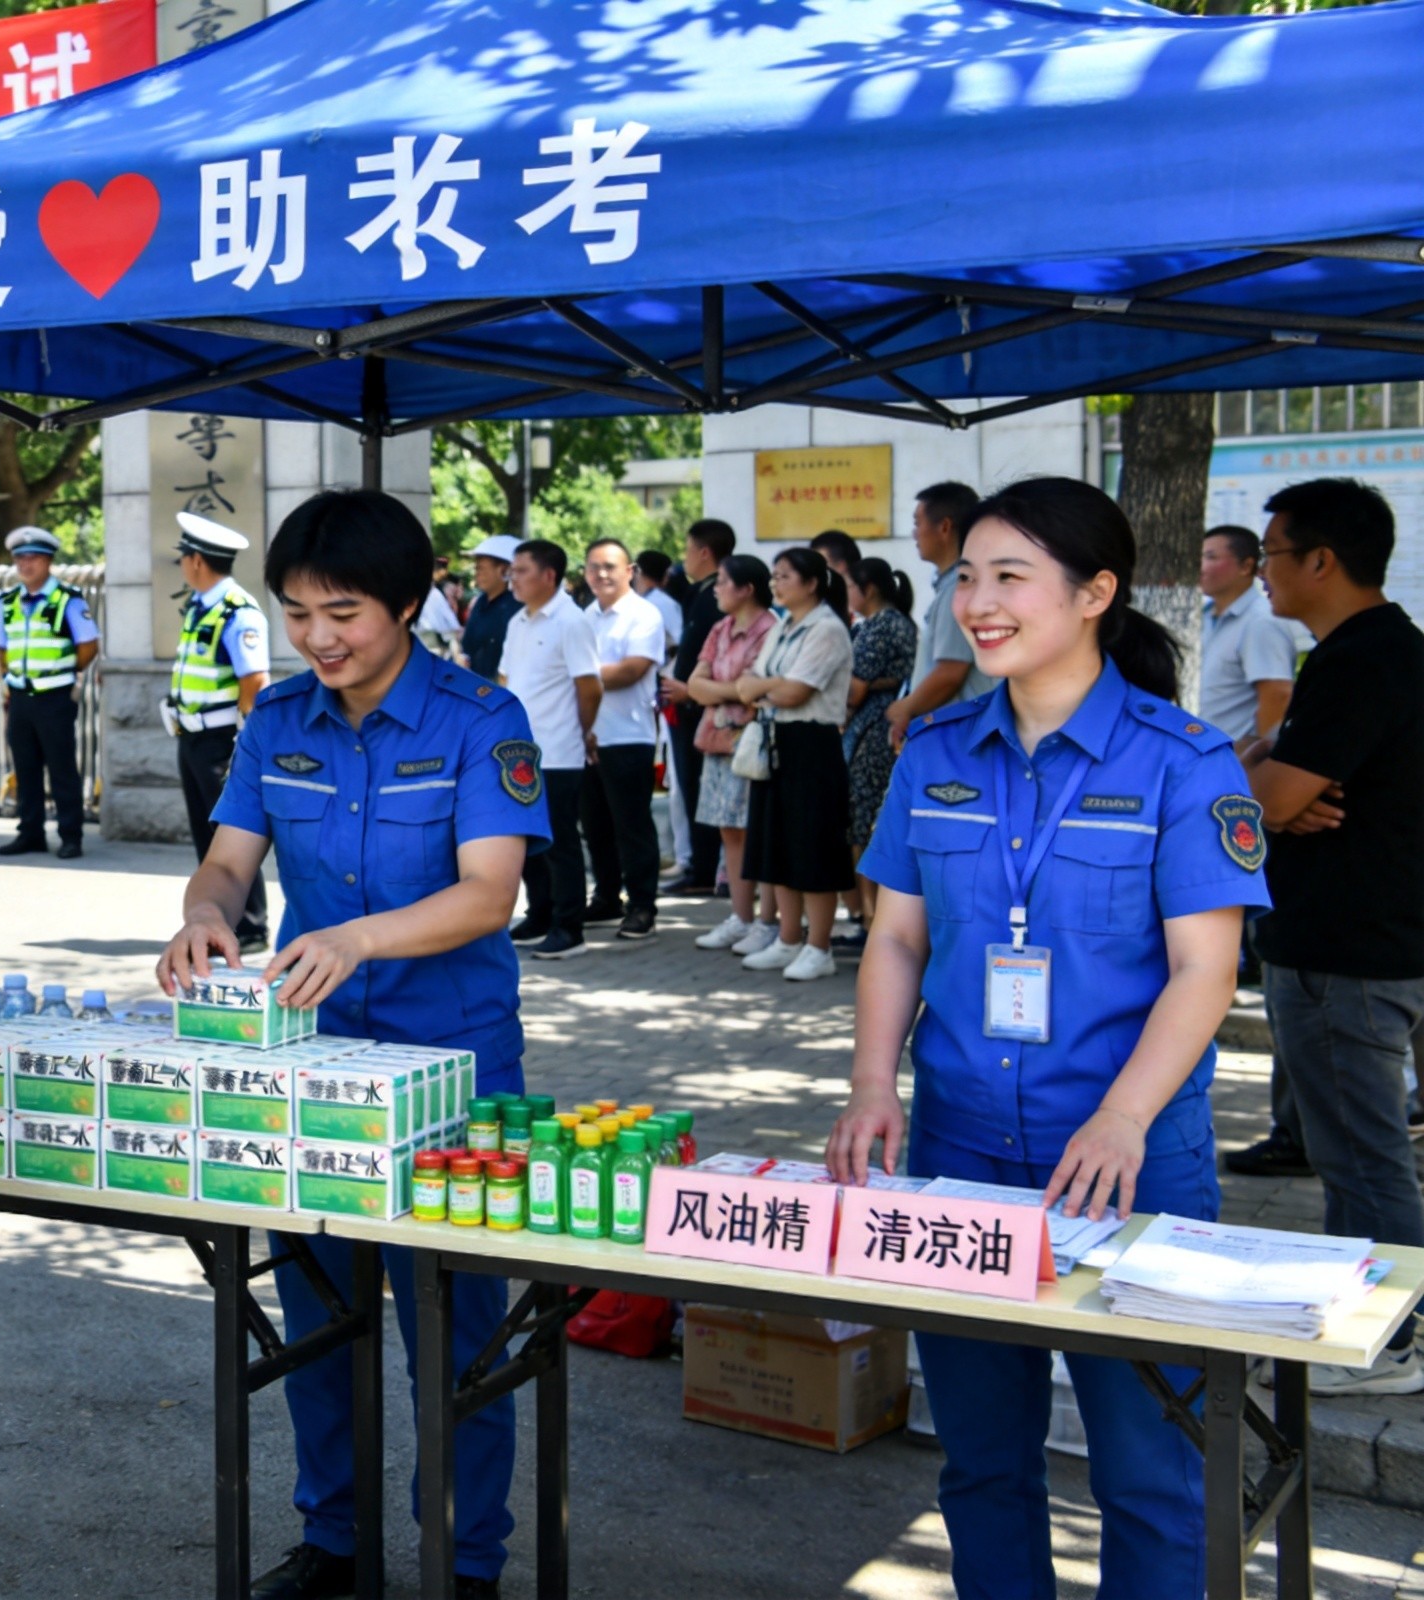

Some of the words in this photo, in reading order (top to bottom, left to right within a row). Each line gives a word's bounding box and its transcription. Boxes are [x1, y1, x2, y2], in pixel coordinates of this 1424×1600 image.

[667, 1189, 811, 1252] 风油精
[864, 1207, 1013, 1276] 清凉油
